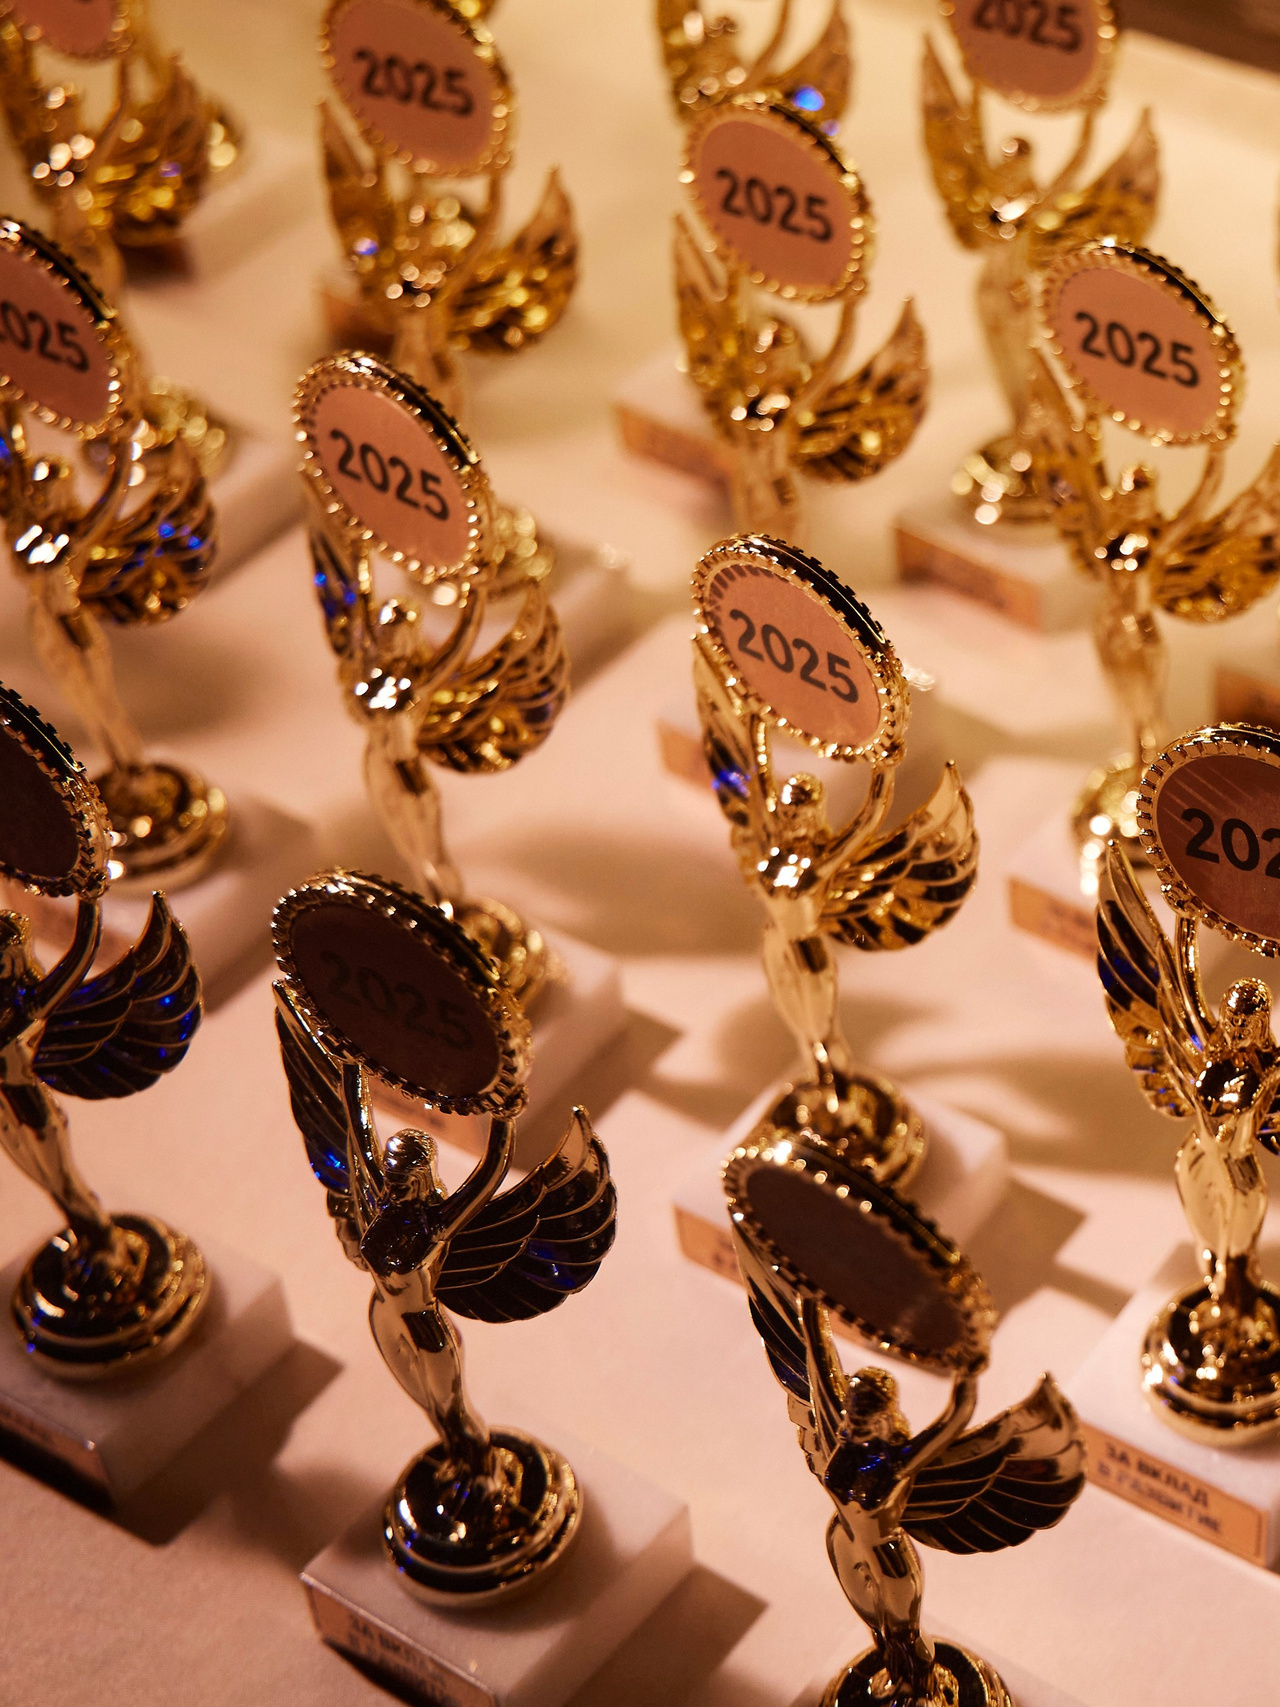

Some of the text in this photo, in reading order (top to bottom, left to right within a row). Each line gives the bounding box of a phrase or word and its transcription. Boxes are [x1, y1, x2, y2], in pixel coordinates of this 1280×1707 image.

[355, 49, 475, 116] 2025
[715, 169, 835, 242] 2025
[0, 300, 89, 372] 025
[1075, 312, 1202, 388] 2025
[329, 430, 450, 521] 2025
[730, 609, 859, 703] 2025
[320, 949, 473, 1049] 2025
